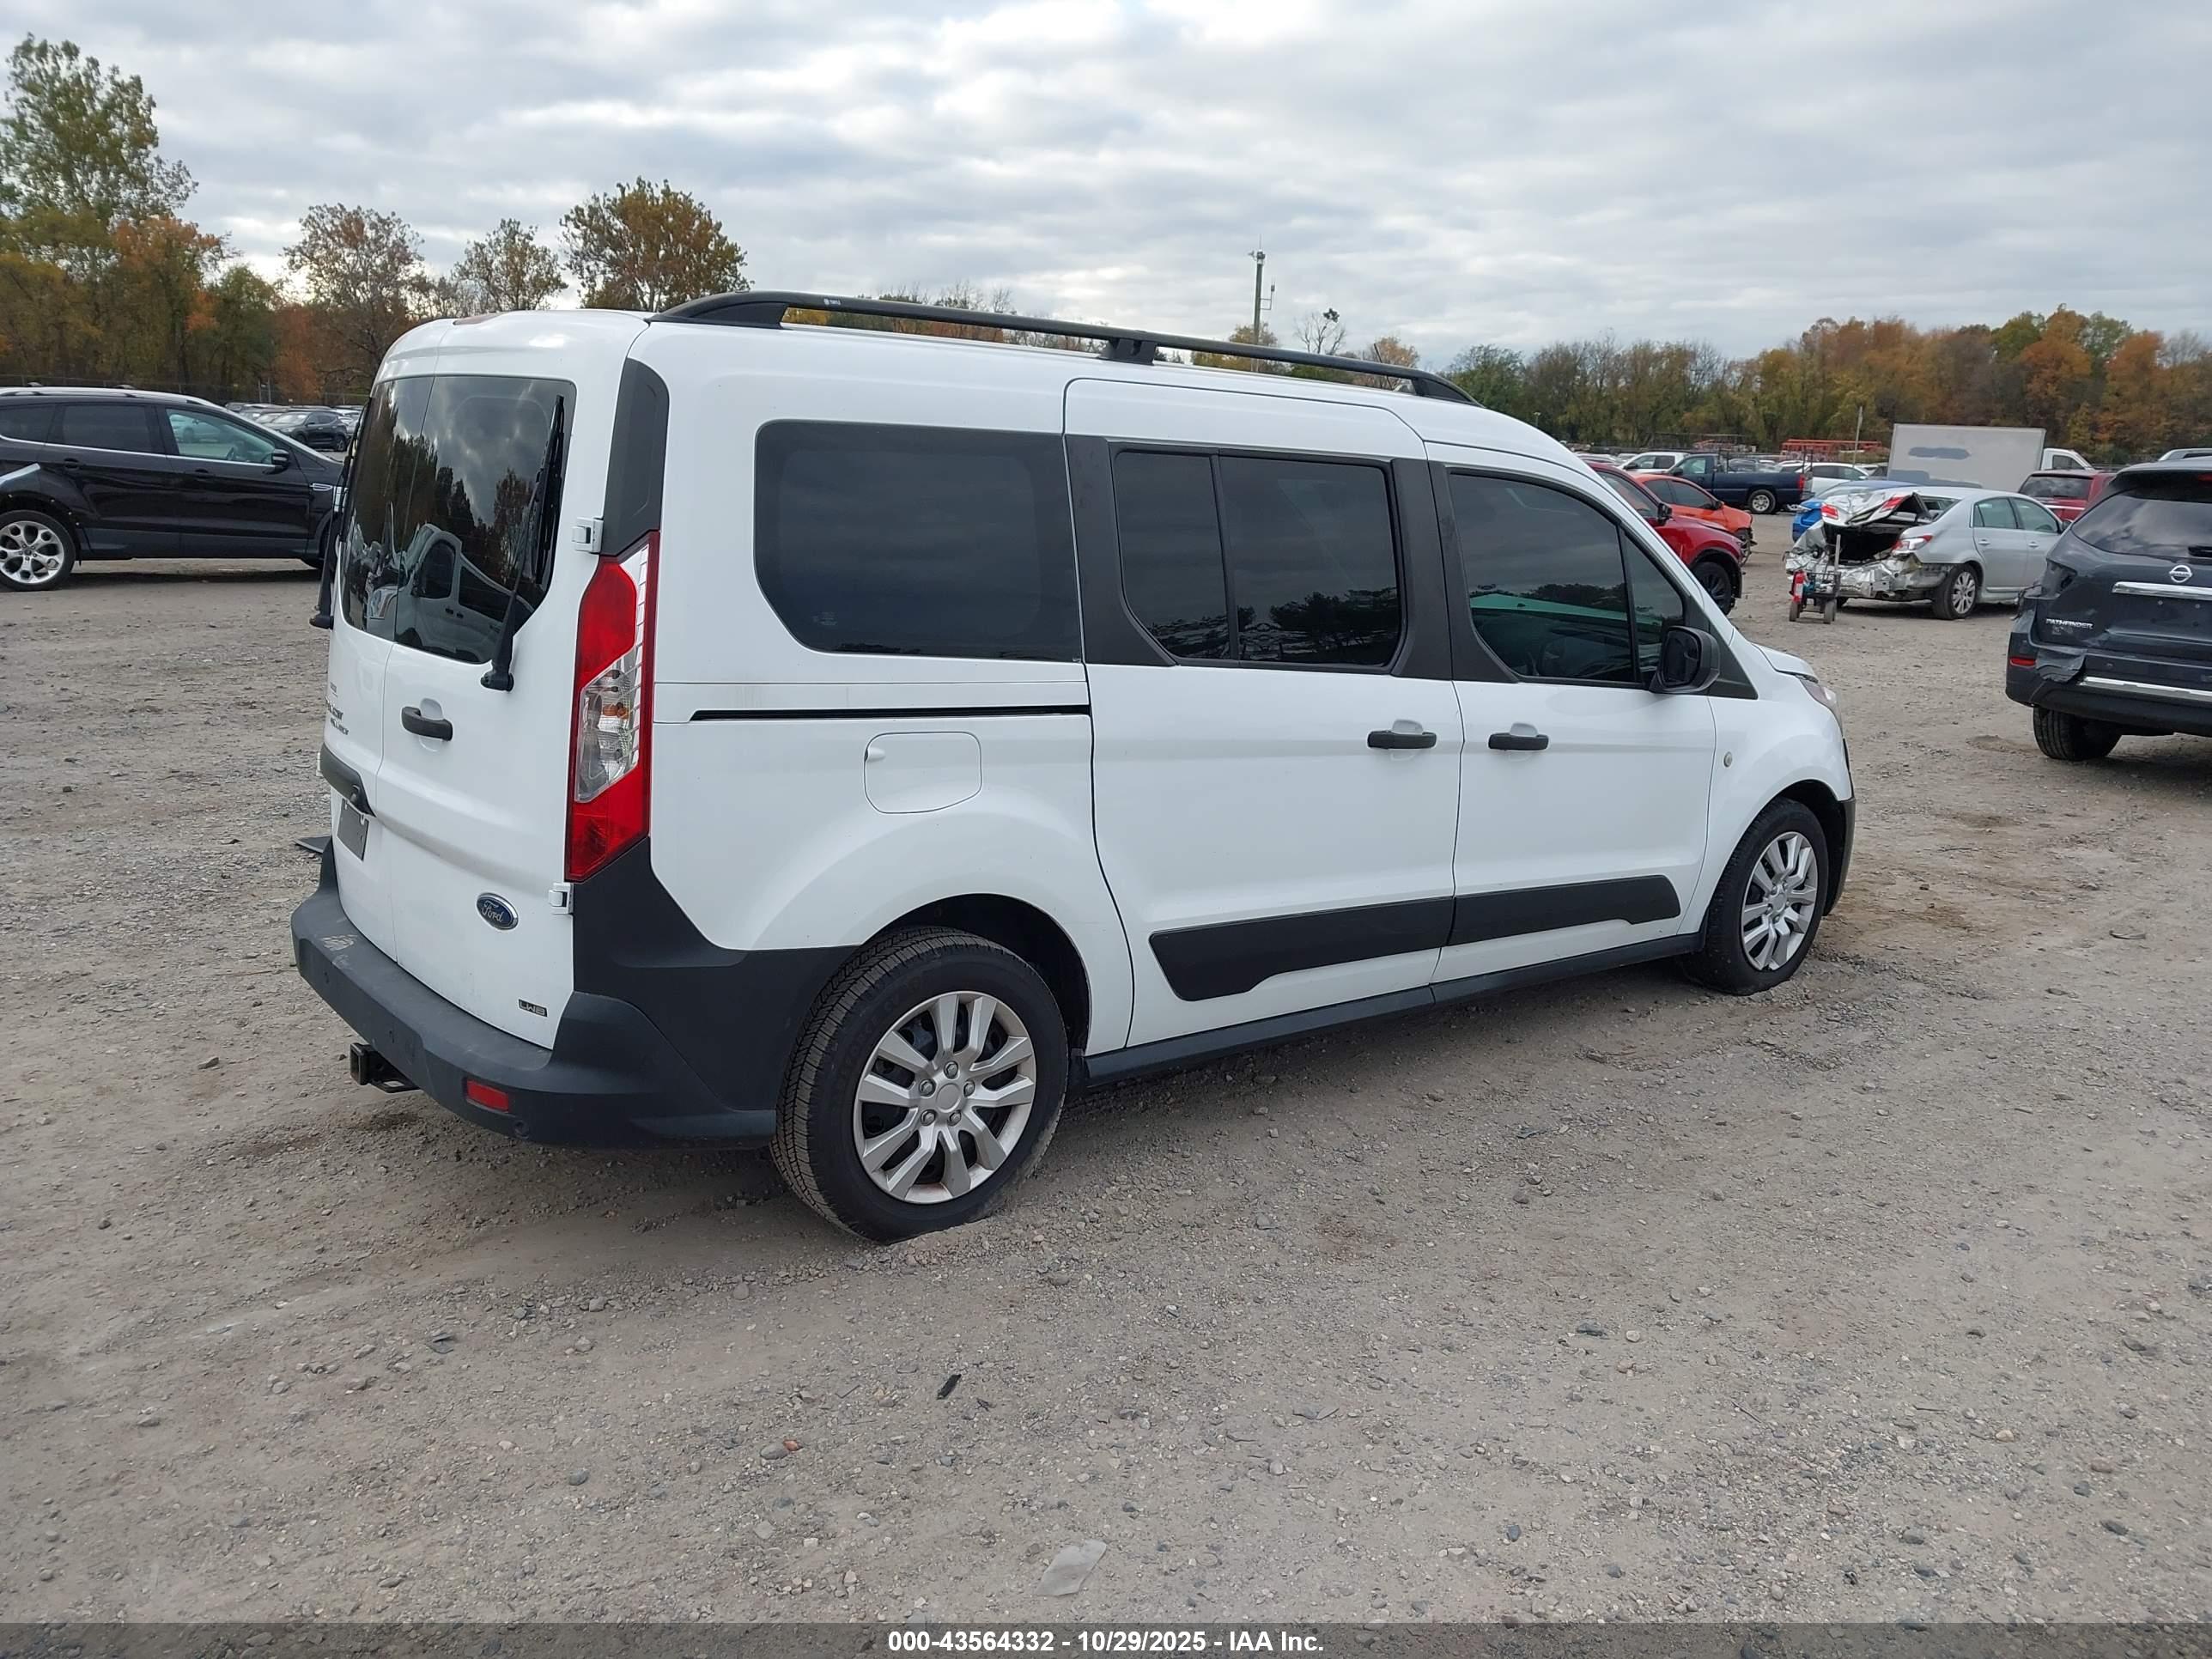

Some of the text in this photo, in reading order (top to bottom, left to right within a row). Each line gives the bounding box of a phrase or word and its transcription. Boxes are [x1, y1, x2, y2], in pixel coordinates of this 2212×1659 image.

[2045, 618, 2094, 629] PATHFINDER
[482, 900, 504, 923] Ford
[520, 1000, 546, 1016] LWB
